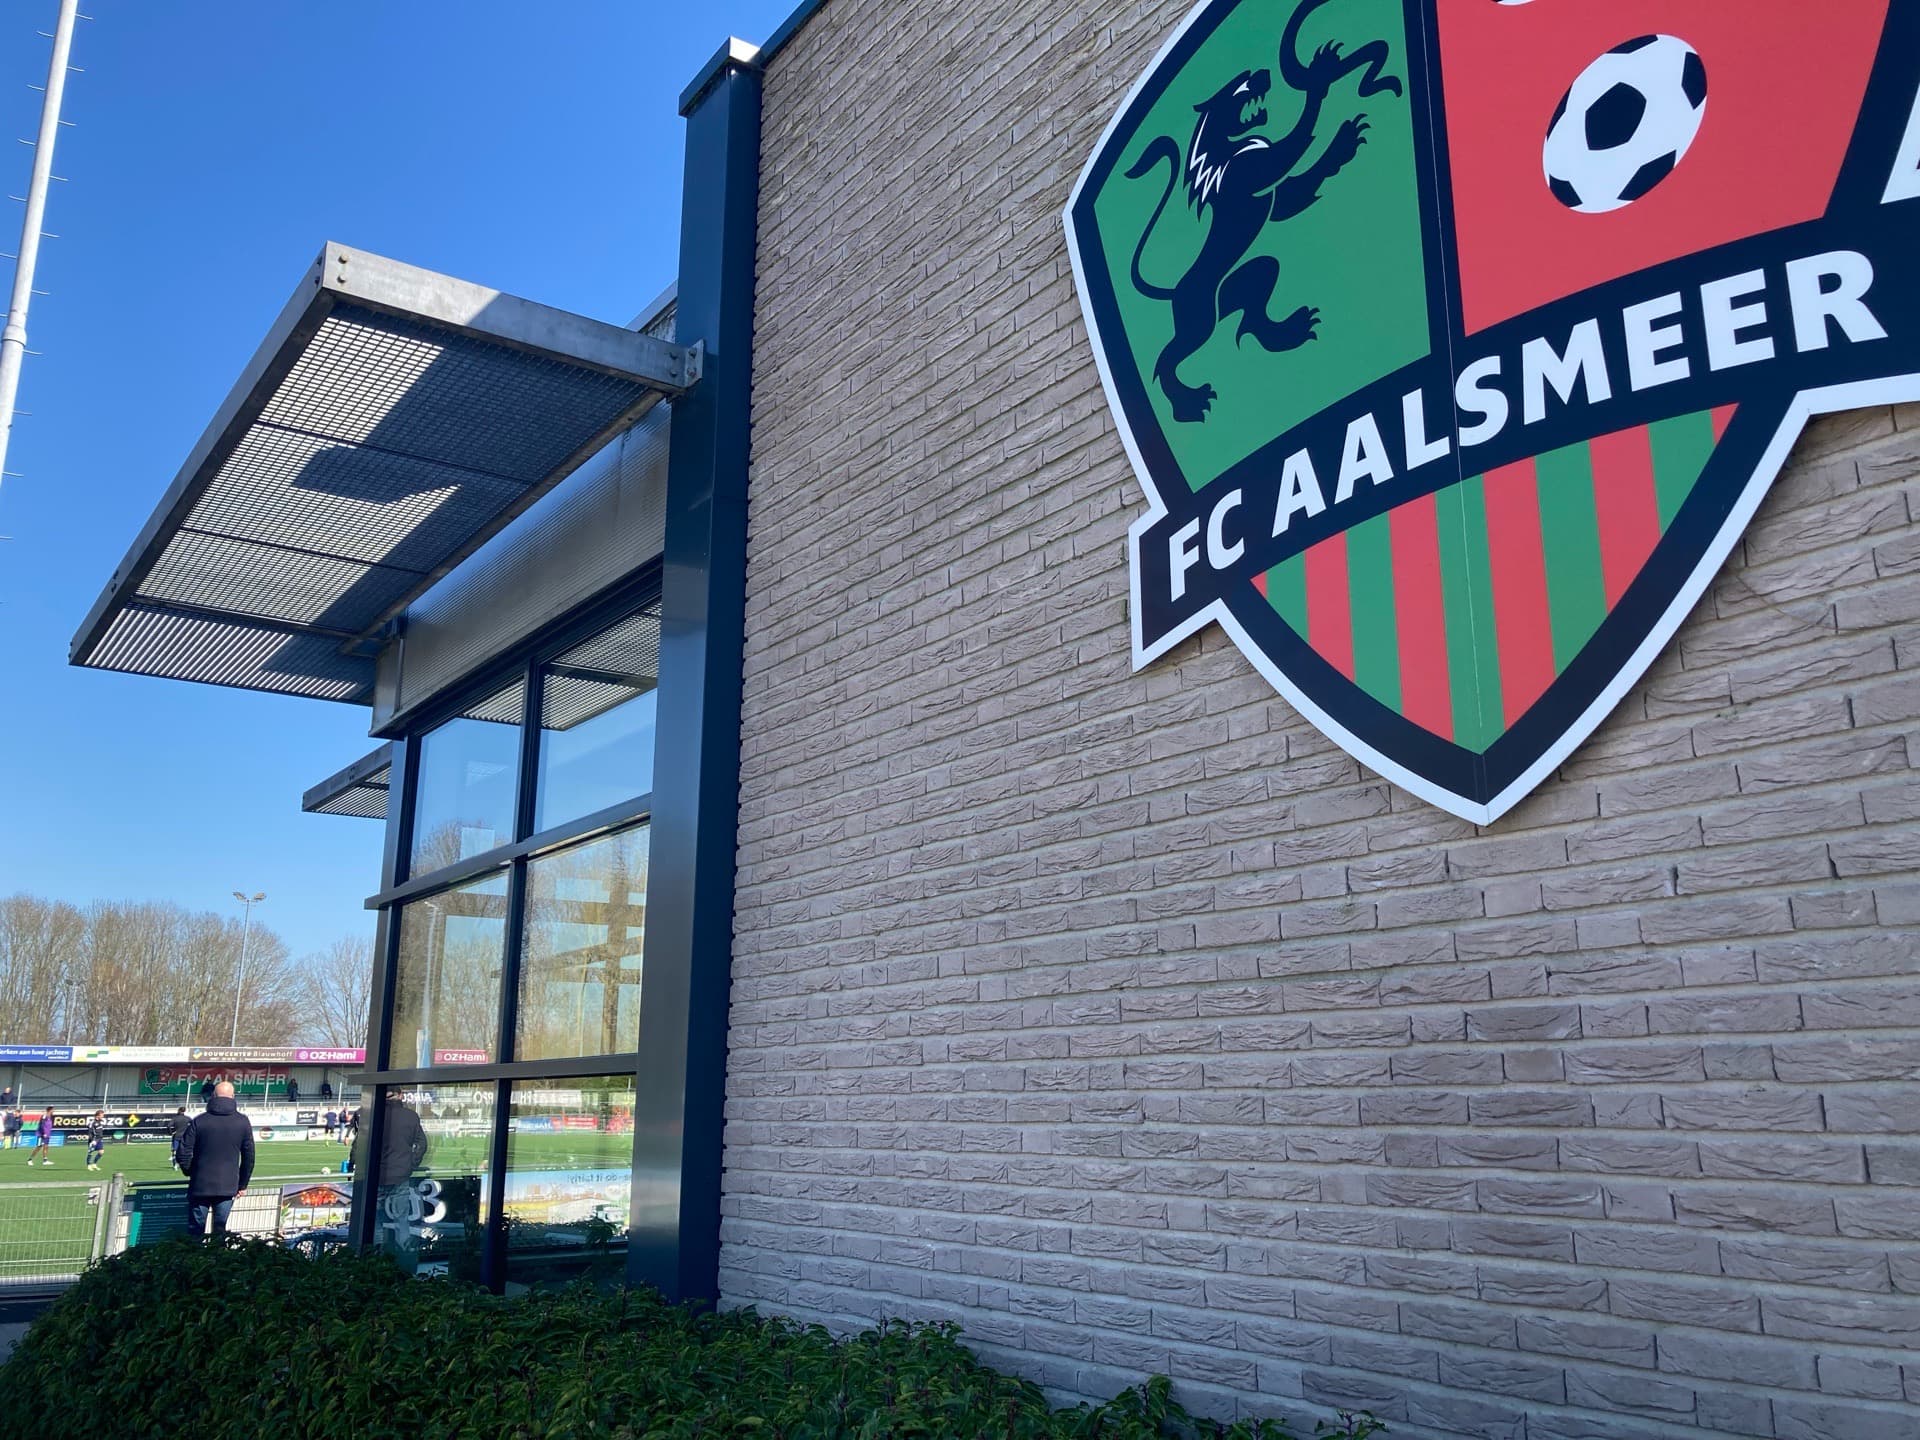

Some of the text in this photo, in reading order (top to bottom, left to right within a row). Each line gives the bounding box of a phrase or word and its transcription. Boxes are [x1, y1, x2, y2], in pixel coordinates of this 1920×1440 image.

[1169, 250, 1889, 603] FC AALSMEER
[177, 1073, 198, 1086] FC
[53, 1116, 123, 1126] RosaPaza
